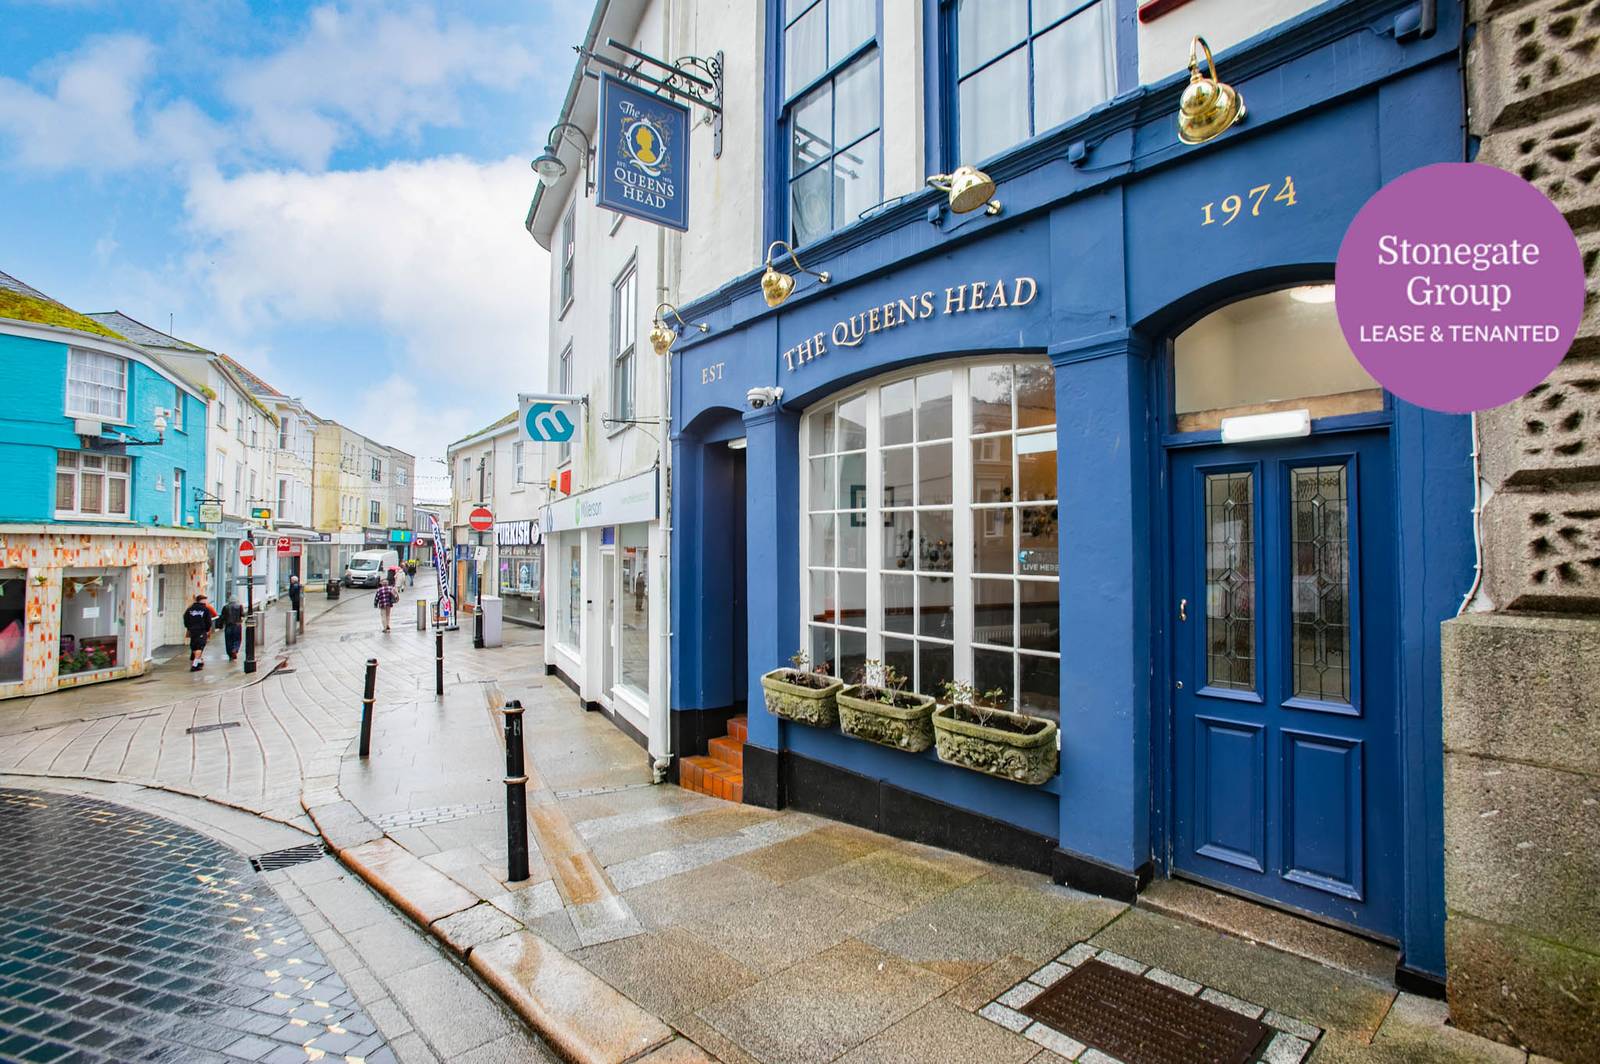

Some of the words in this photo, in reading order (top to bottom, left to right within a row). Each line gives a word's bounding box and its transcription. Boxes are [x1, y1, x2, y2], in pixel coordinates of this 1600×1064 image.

[619, 101, 641, 118] The
[614, 167, 674, 197] QUEENS
[623, 185, 666, 209] HEAD
[1201, 176, 1297, 227] 1974
[783, 332, 826, 372] THE
[832, 291, 935, 346] QUEENS
[943, 277, 1037, 314] HEAD
[702, 362, 725, 385] EST
[494, 521, 530, 545] TURKISH
[1023, 563, 1038, 571] LIVE
